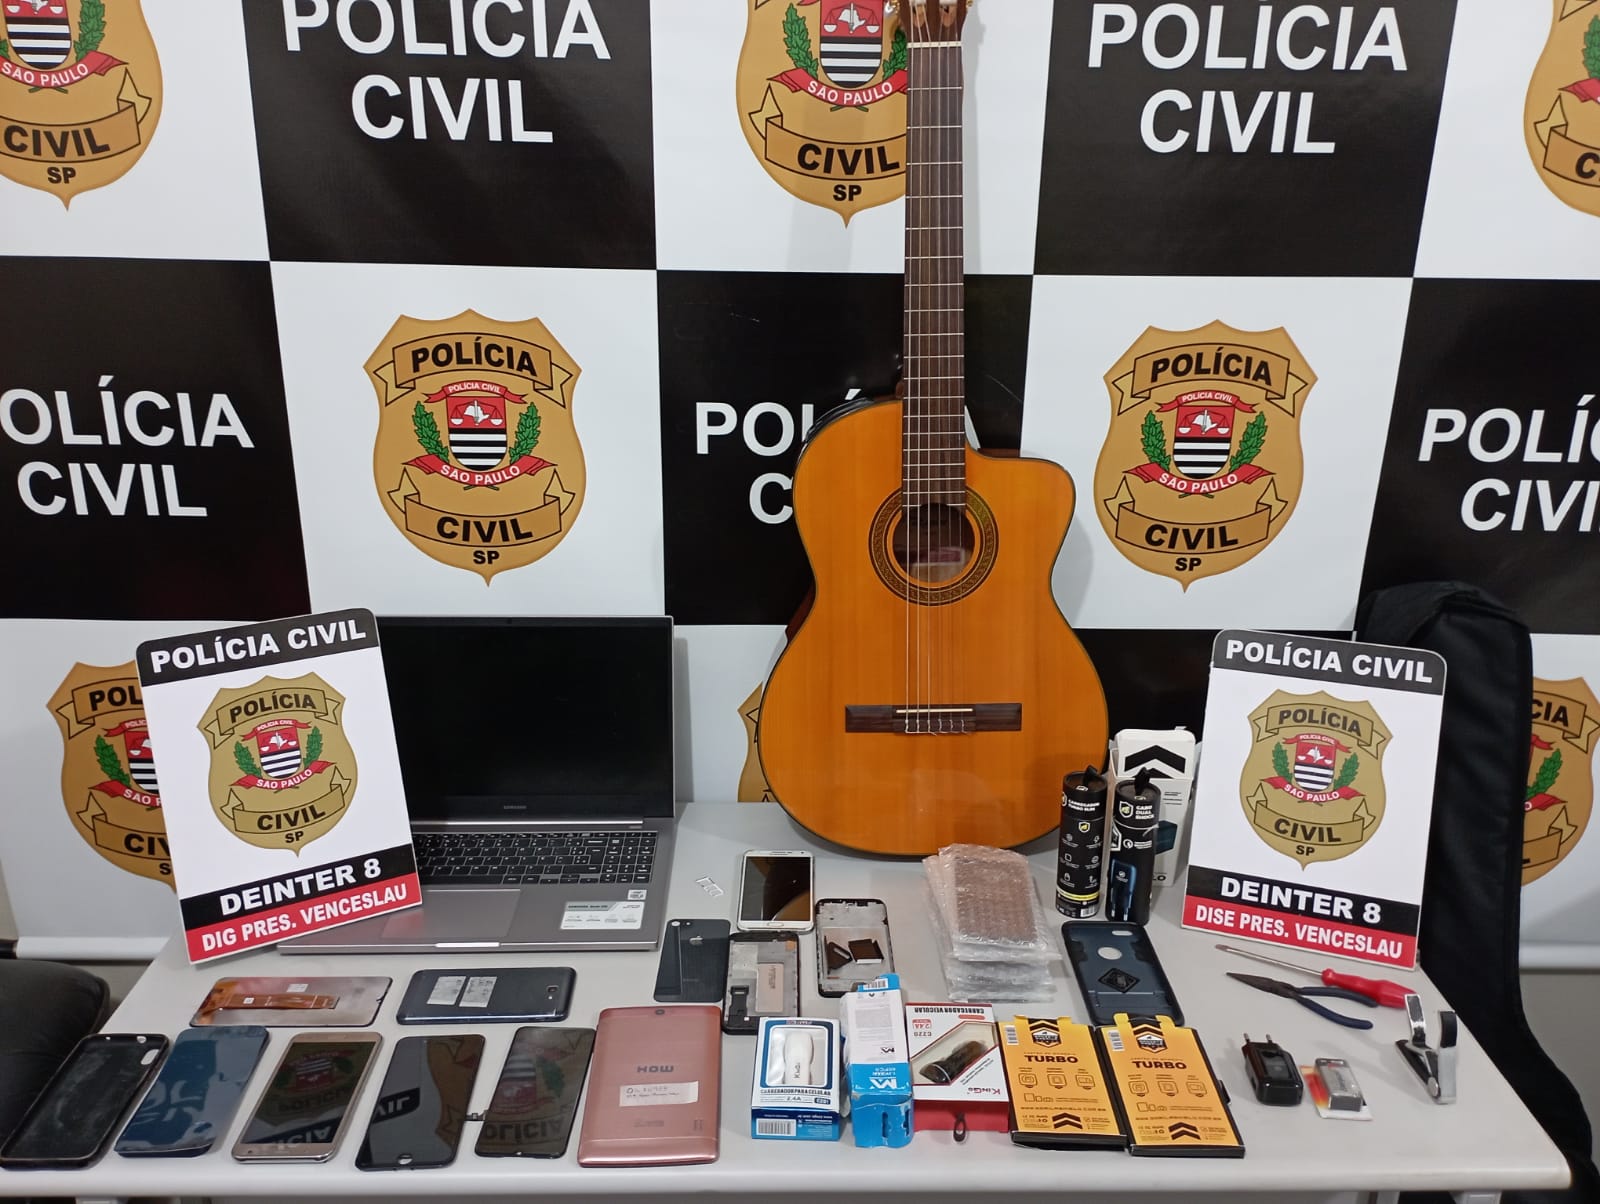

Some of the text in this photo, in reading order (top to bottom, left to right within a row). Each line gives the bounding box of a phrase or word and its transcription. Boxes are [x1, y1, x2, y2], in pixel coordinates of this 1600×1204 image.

[41, 63, 89, 87] PAULO
[844, 82, 893, 105] PAULO
[352, 74, 553, 143] CIVIL
[1141, 89, 1336, 154] CIVIL
[4, 125, 111, 158] CIVIL
[798, 143, 900, 175] CIVIL
[47, 167, 76, 184] SP
[833, 184, 862, 201] SP
[411, 336, 538, 377] POLÍCIA
[1150, 347, 1272, 387] POLÍCIA
[482, 383, 501, 394] CIVIL
[1214, 392, 1233, 403] CIVIL
[0, 375, 255, 448] OLÍCIA
[475, 465, 520, 485] PAULO
[1191, 473, 1238, 493] PAULO
[17, 461, 208, 517] CIVIL
[436, 516, 533, 543] CIVIL
[1144, 524, 1238, 550] CIVIL
[473, 550, 500, 565] SP
[1175, 557, 1202, 572] SP
[150, 619, 366, 673] POLÍCIA CIVIL
[1225, 639, 1433, 683] POLÍCIA CIVIL
[229, 691, 317, 724] POLÍCIA
[1278, 707, 1362, 737] POLÍCIA
[281, 769, 313, 788] PAULO
[1307, 791, 1340, 802] PAULO
[256, 803, 325, 831] CIVIL
[1274, 818, 1342, 842] CIVIL
[285, 830, 304, 844] SP
[1295, 845, 1315, 857] SP
[219, 858, 382, 916] DEINTER 8
[1221, 876, 1381, 924] DEINTER 8
[201, 883, 408, 953] DIG PRES. VENCESLAU
[1195, 904, 1403, 959] DISE PRES. VENCESLAU
[1024, 1055, 1078, 1063] TURBO
[1132, 1061, 1187, 1069] TURBO
